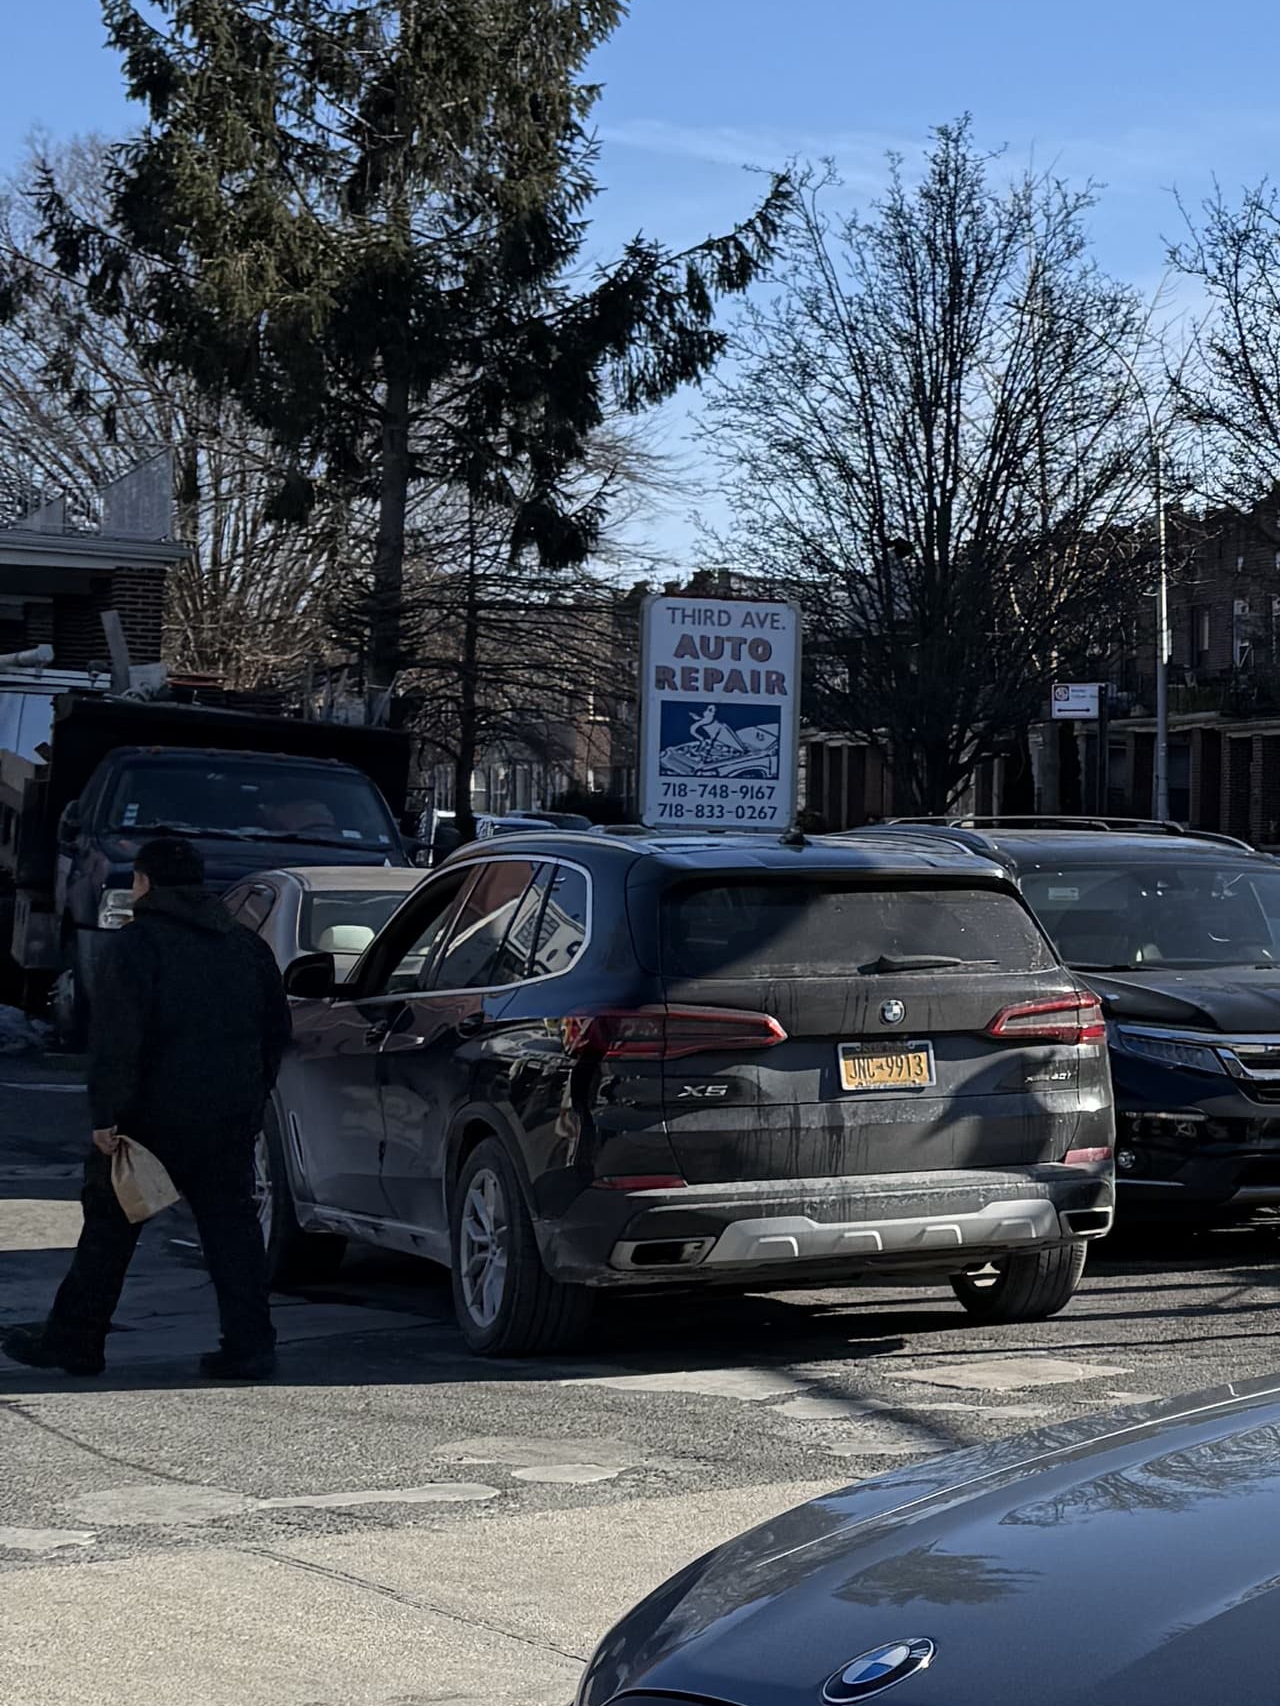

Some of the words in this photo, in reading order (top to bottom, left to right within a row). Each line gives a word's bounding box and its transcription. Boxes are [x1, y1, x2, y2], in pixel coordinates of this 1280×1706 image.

[666, 607, 731, 627] THIRD
[741, 611, 786, 630] AVE.
[673, 634, 772, 663] AUTO
[655, 665, 788, 695] REPAIR
[661, 782, 776, 800] 718-748-9167
[658, 804, 777, 820] 718-833-0267
[677, 1084, 728, 1098] X5
